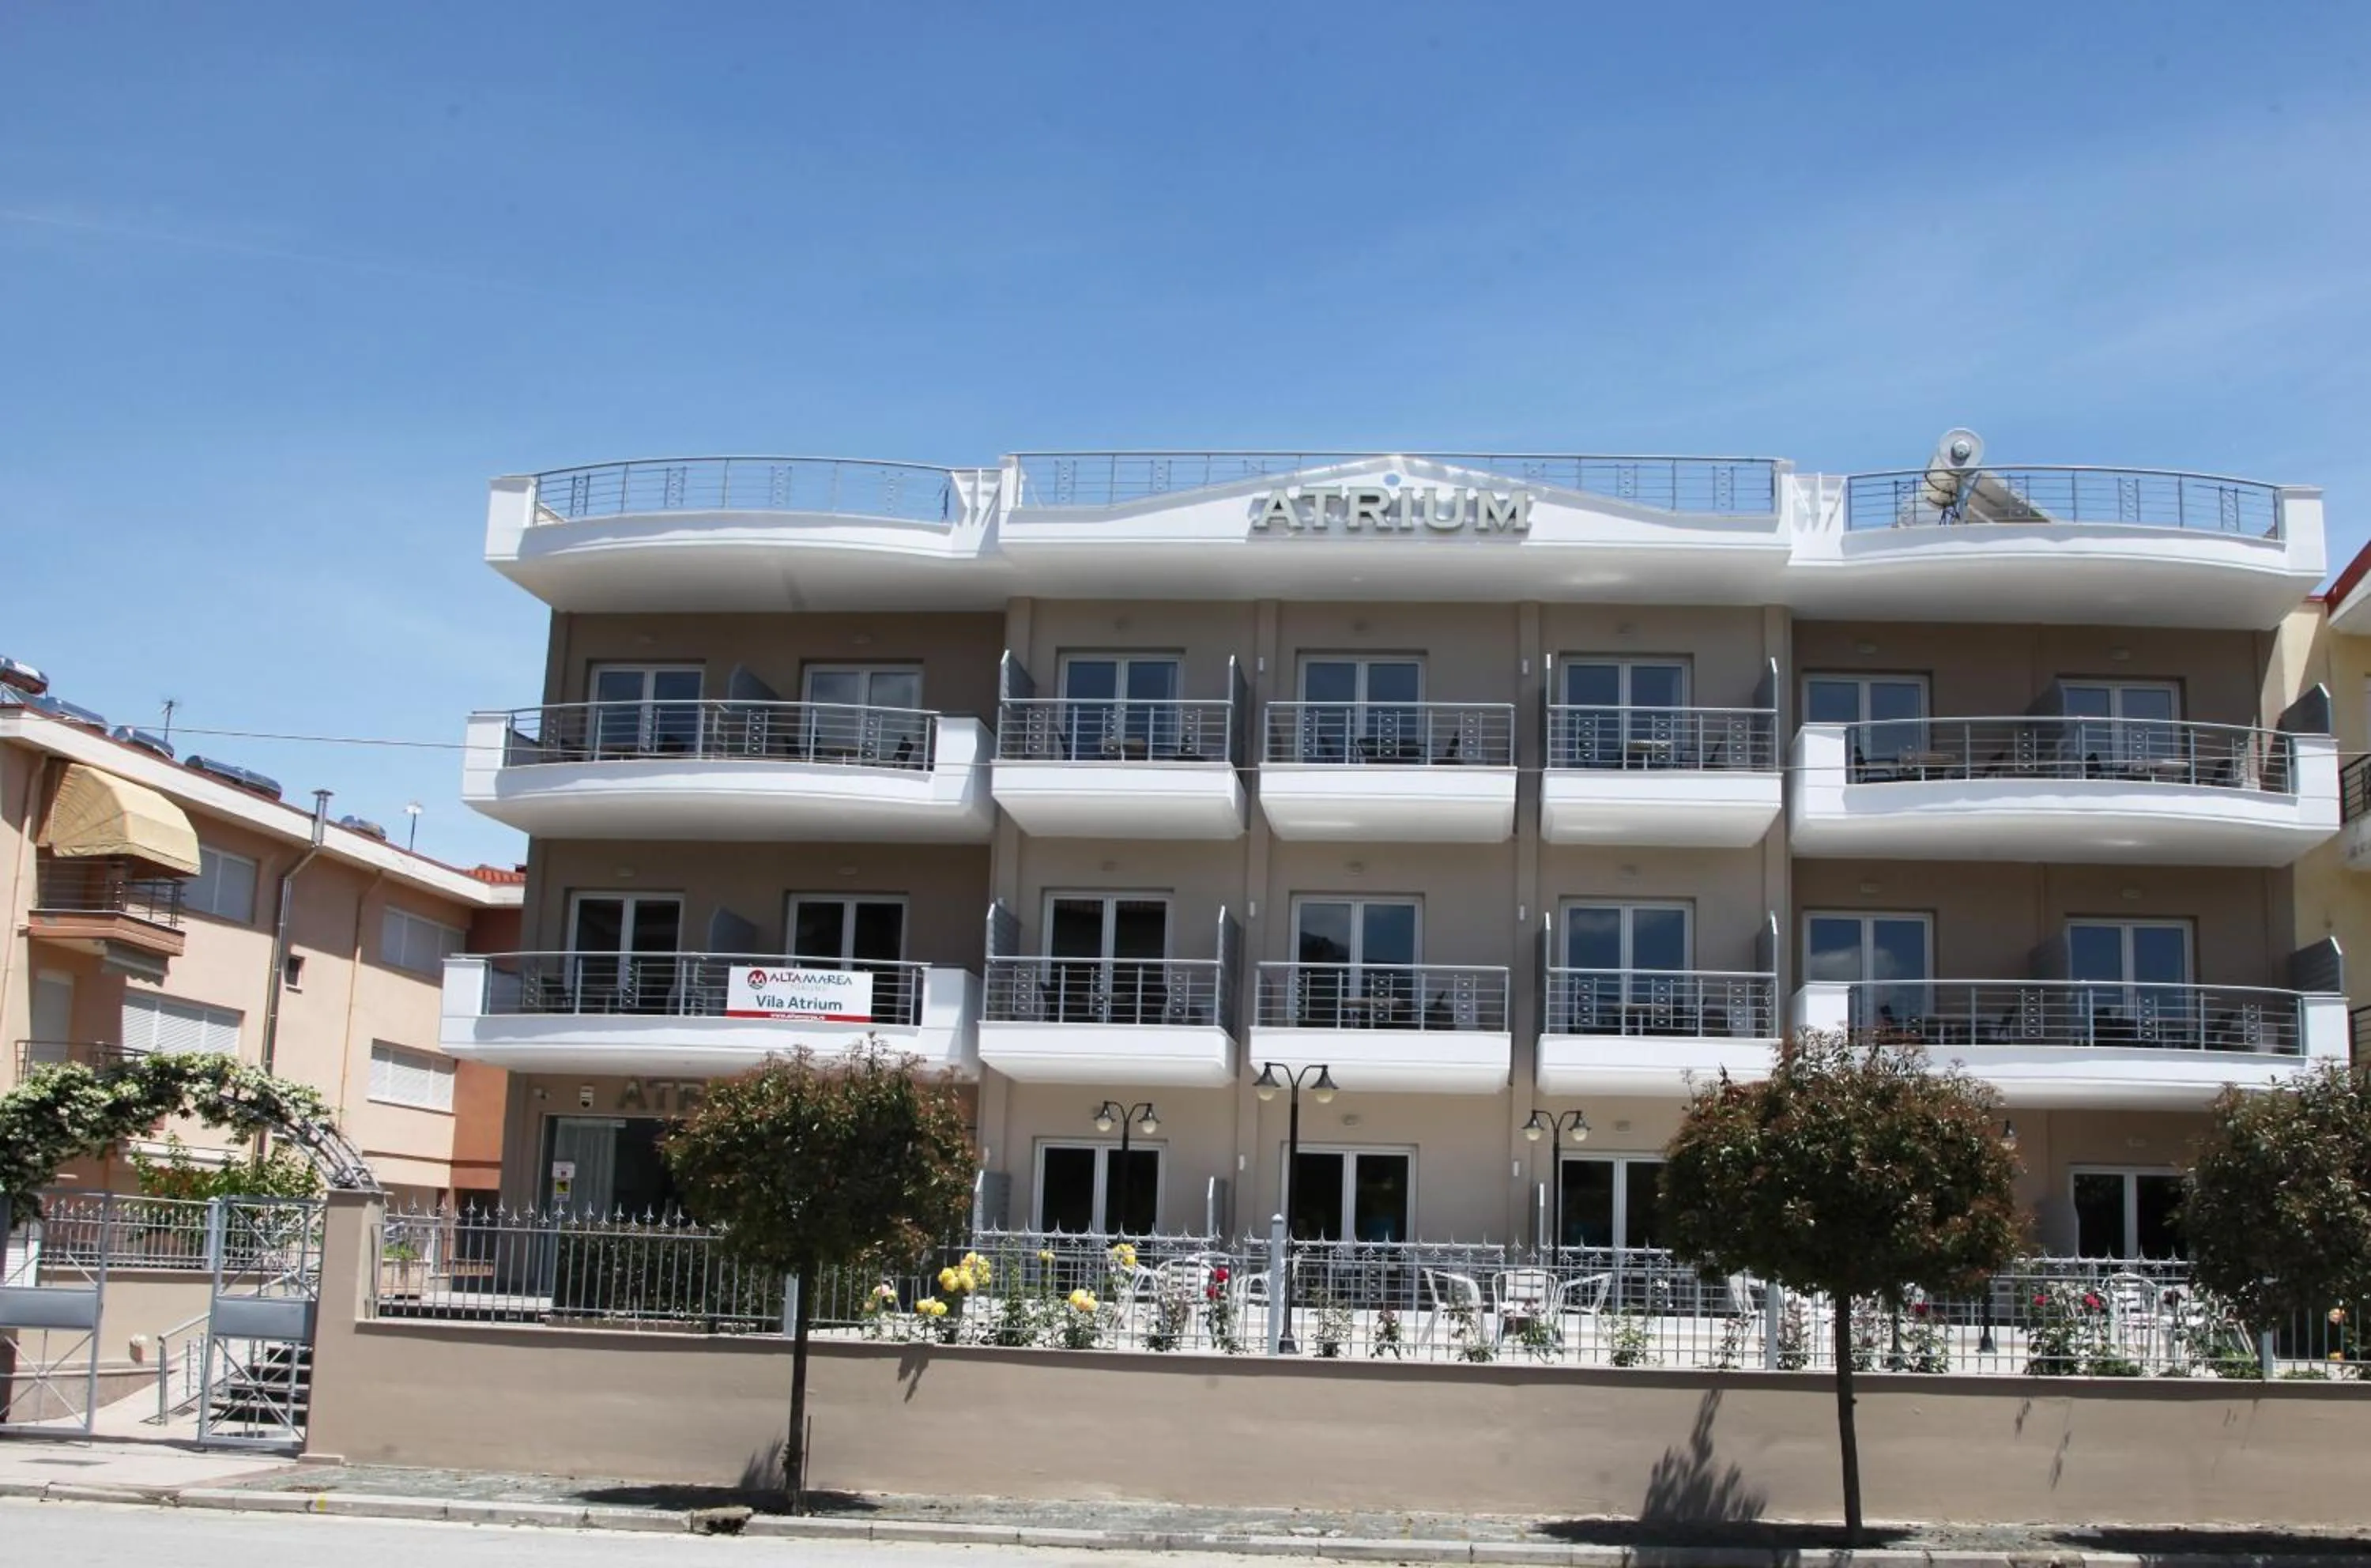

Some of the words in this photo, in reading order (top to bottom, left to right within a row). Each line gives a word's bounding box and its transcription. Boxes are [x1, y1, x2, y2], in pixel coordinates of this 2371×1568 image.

[1253, 485, 1532, 533] ATRIUM
[769, 971, 853, 986] ALTAMAREA
[756, 994, 784, 1008] Vila
[788, 996, 842, 1012] Atrium
